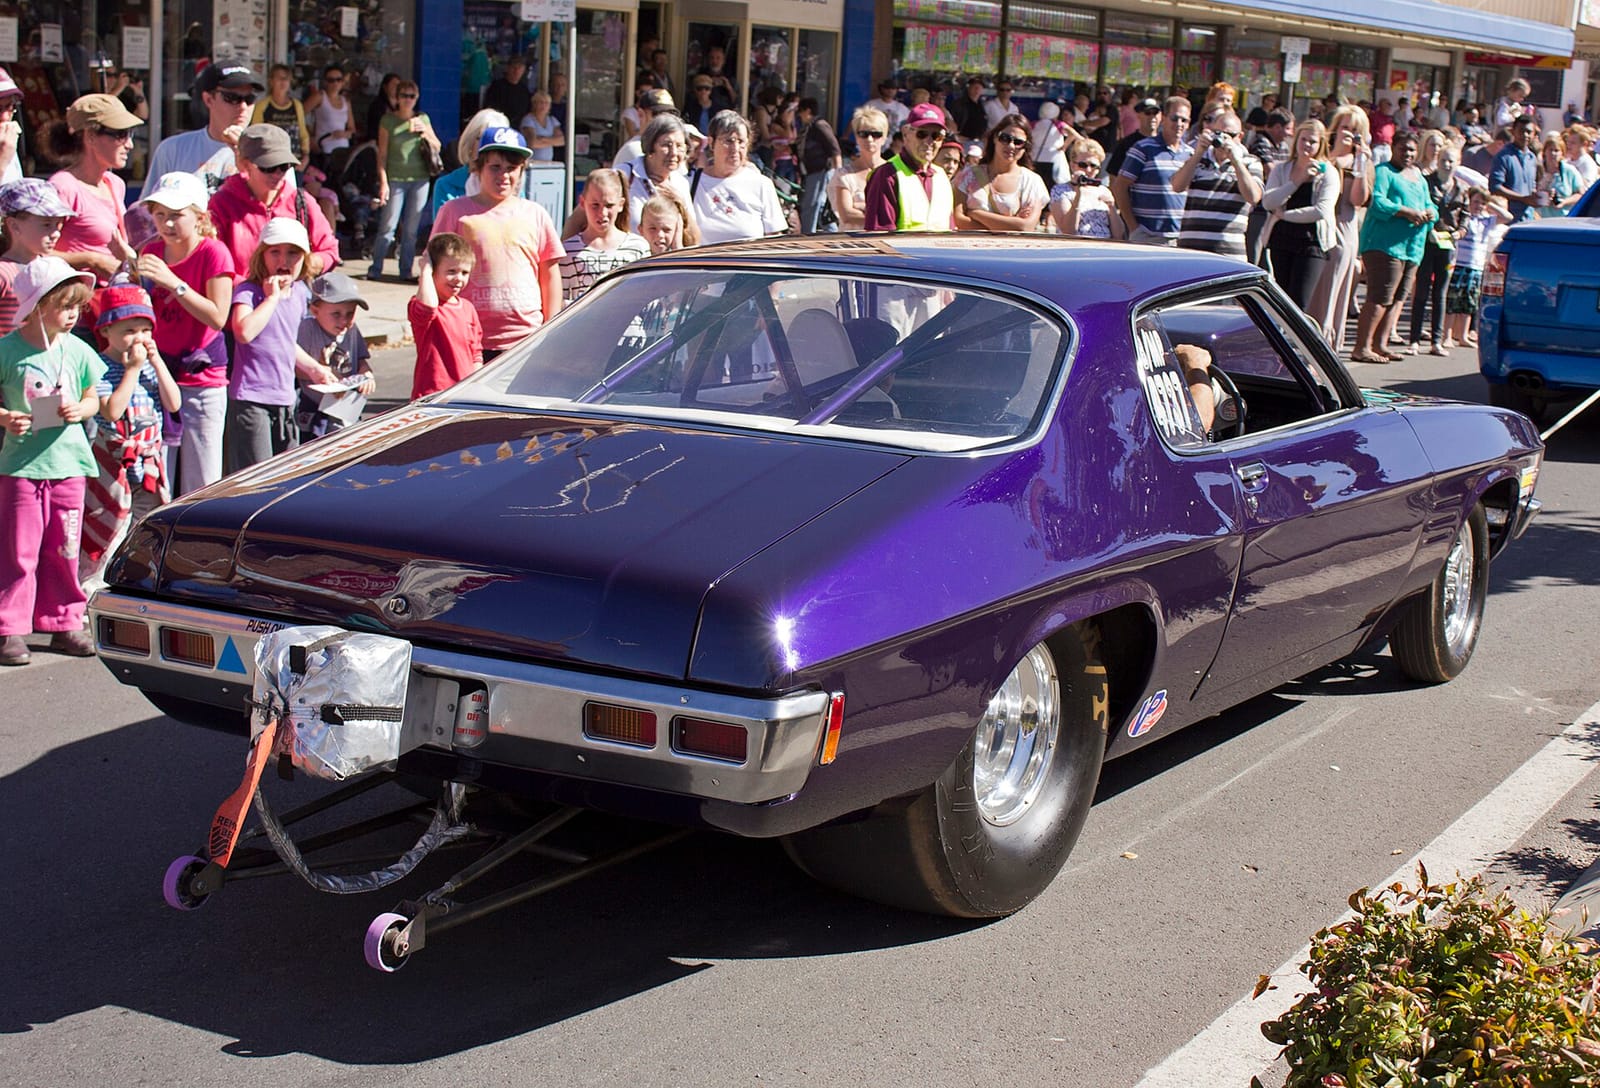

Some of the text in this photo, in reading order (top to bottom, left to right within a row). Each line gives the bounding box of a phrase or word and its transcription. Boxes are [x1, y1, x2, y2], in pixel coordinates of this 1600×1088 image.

[68, 509, 79, 541] DORA
[245, 619, 271, 634] PUSH
[471, 694, 483, 702] ON
[466, 713, 480, 721] OFF
